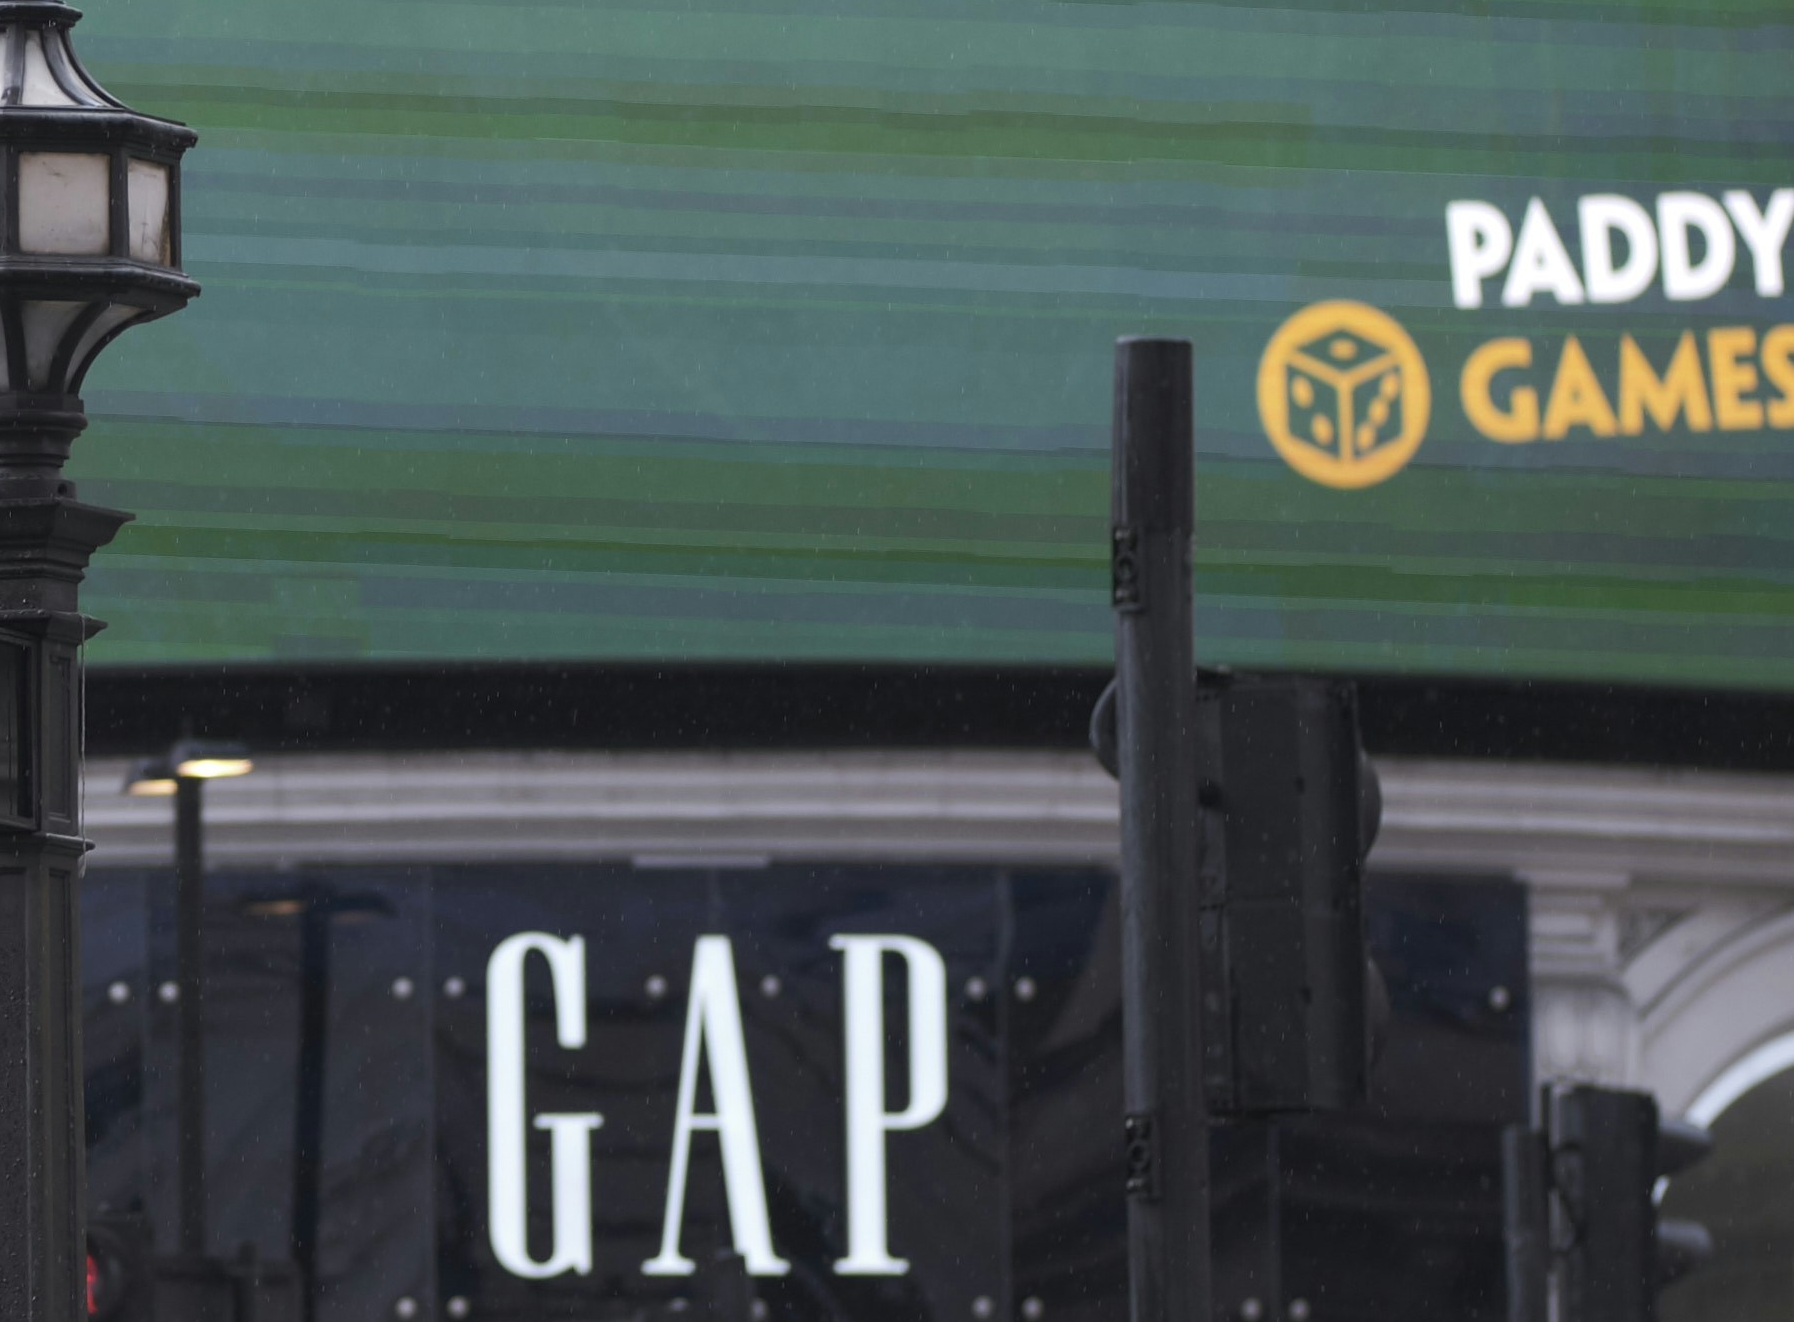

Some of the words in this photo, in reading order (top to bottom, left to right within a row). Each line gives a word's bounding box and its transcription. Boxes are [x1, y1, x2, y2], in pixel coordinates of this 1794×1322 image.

[1444, 187, 1794, 310] PADDY
[1459, 322, 1794, 444] GAMES
[486, 930, 950, 1279] GAP
